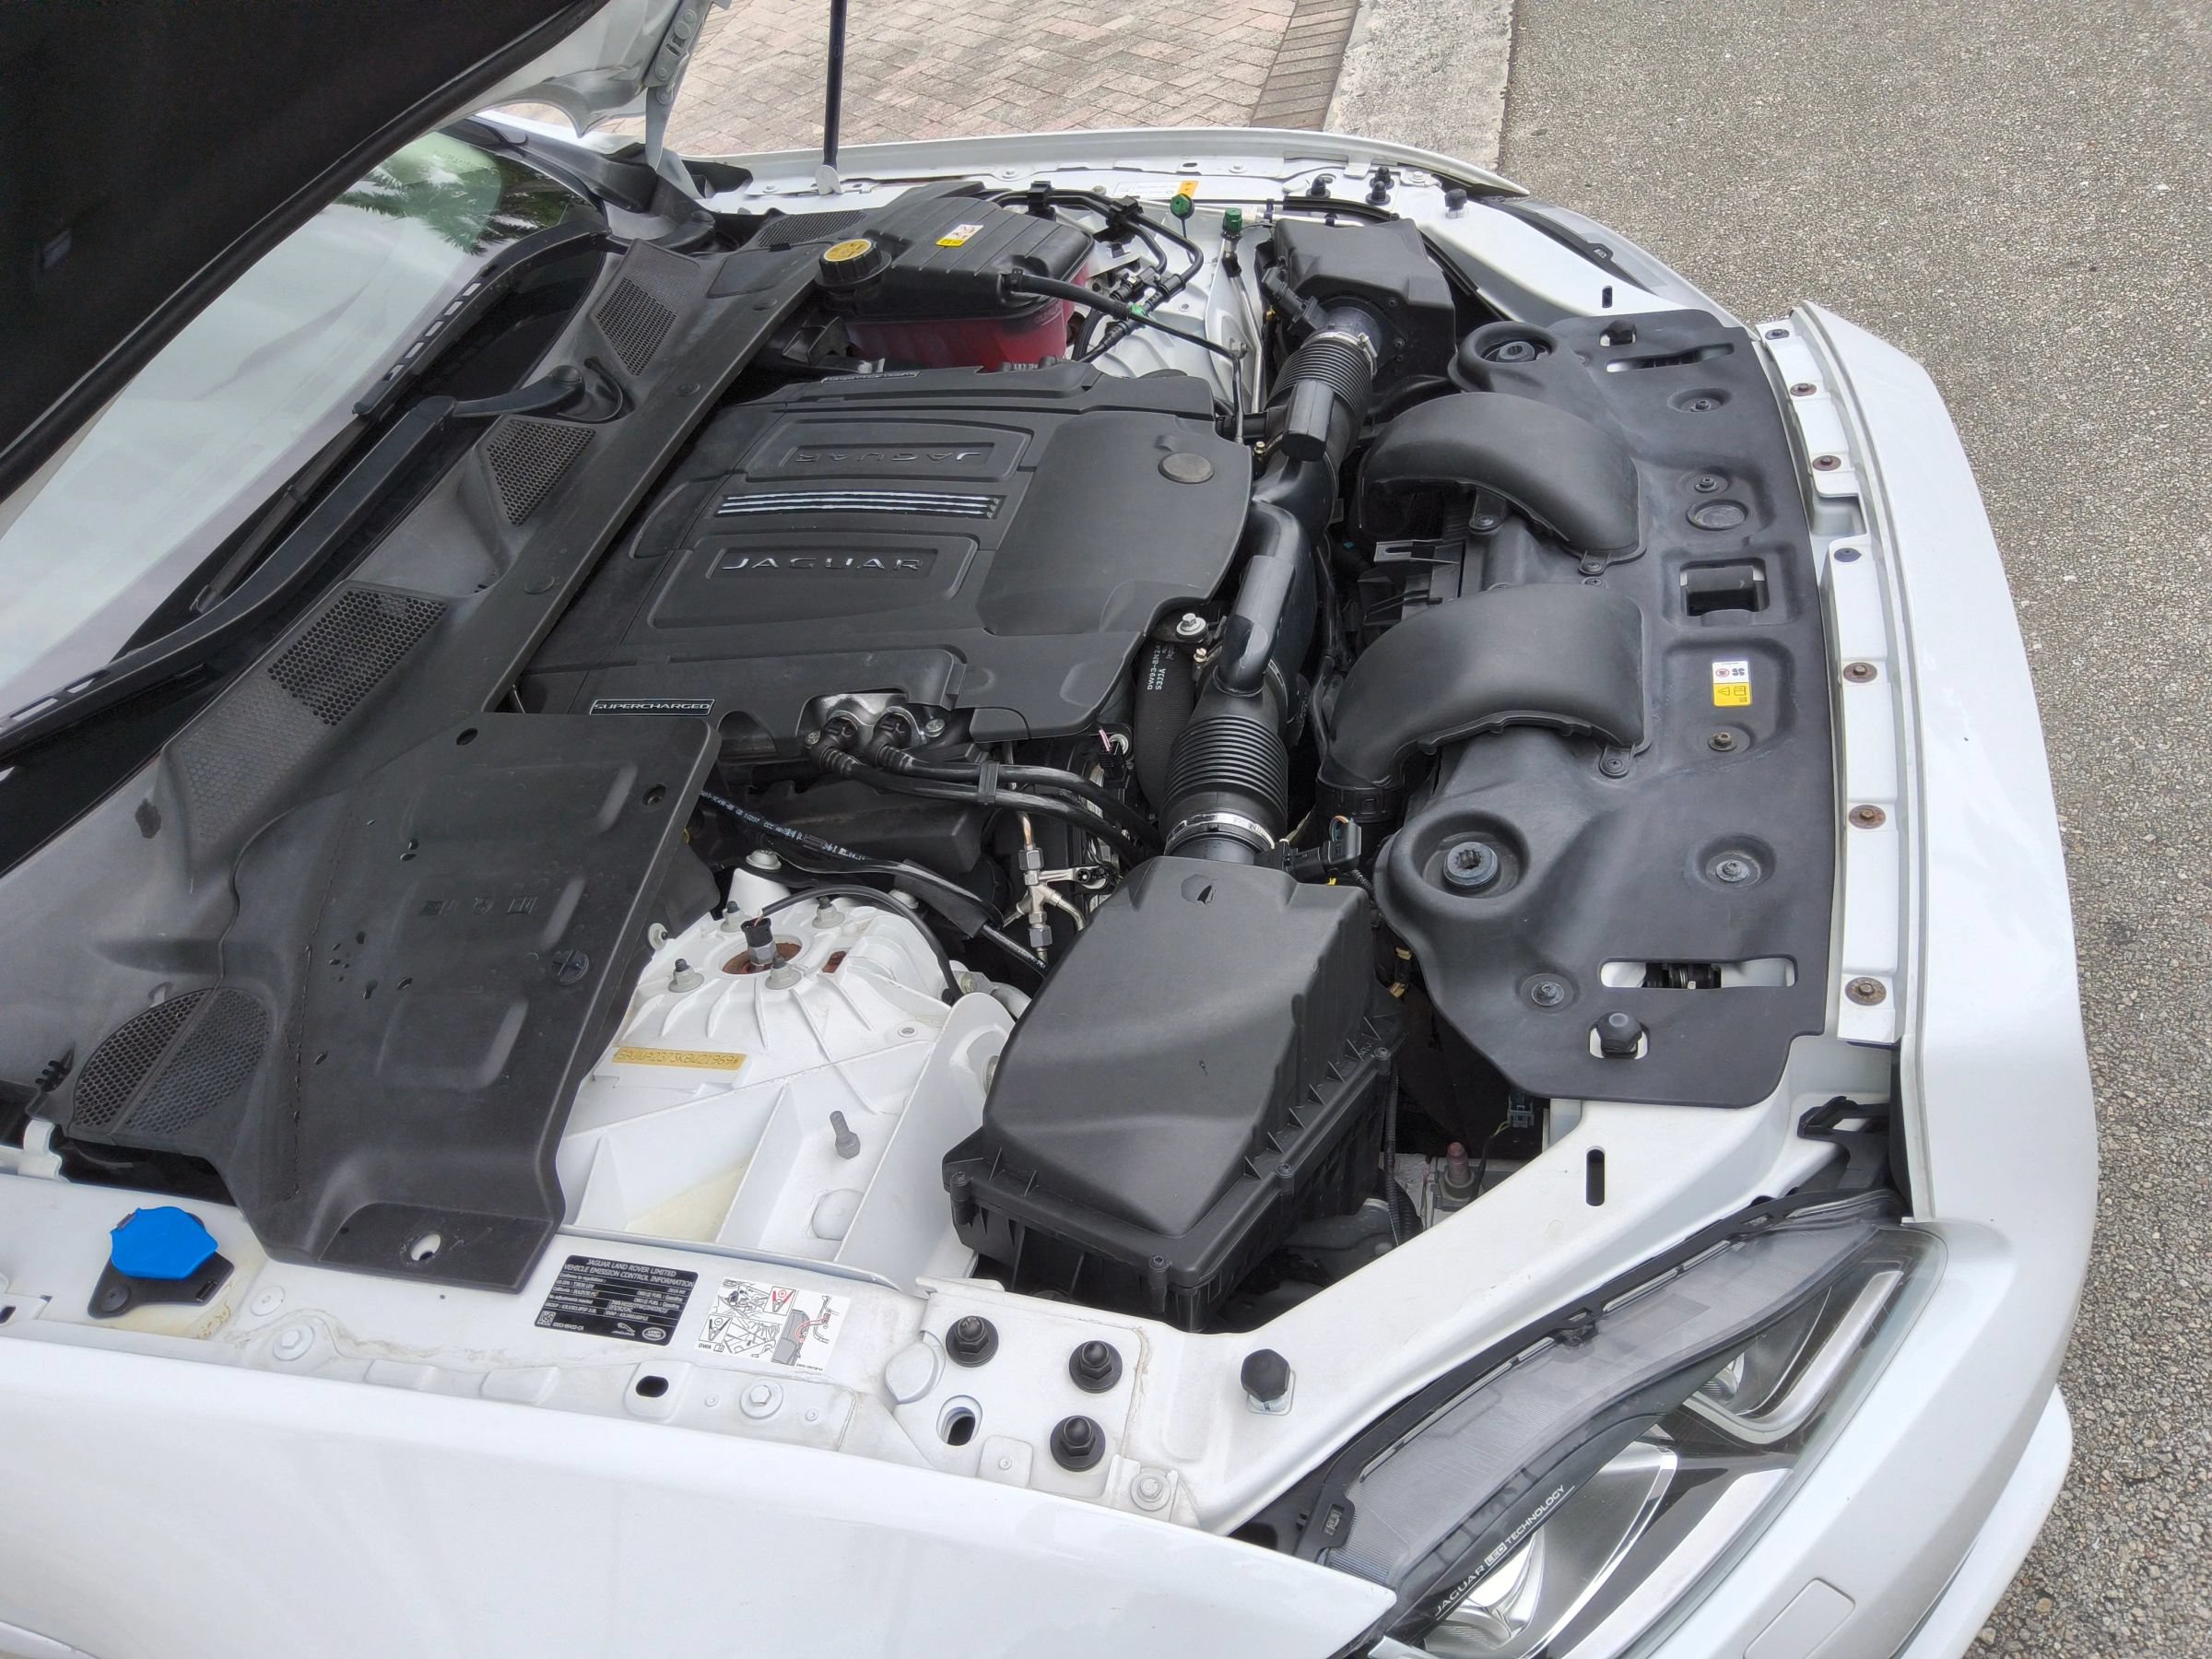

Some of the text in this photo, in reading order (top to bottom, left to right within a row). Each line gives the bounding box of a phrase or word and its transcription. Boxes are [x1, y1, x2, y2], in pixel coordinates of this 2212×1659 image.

[795, 452, 982, 463] JAGUAR
[722, 558, 924, 571] JAGUAR
[594, 702, 710, 711] SUPERCHARGED
[590, 1267, 619, 1276] EMISSION
[620, 1272, 650, 1280] CONTROL
[651, 1277, 694, 1287] INFORMATION
[1435, 1485, 1565, 1617] JAGUAR LED TECHNOLOGY
